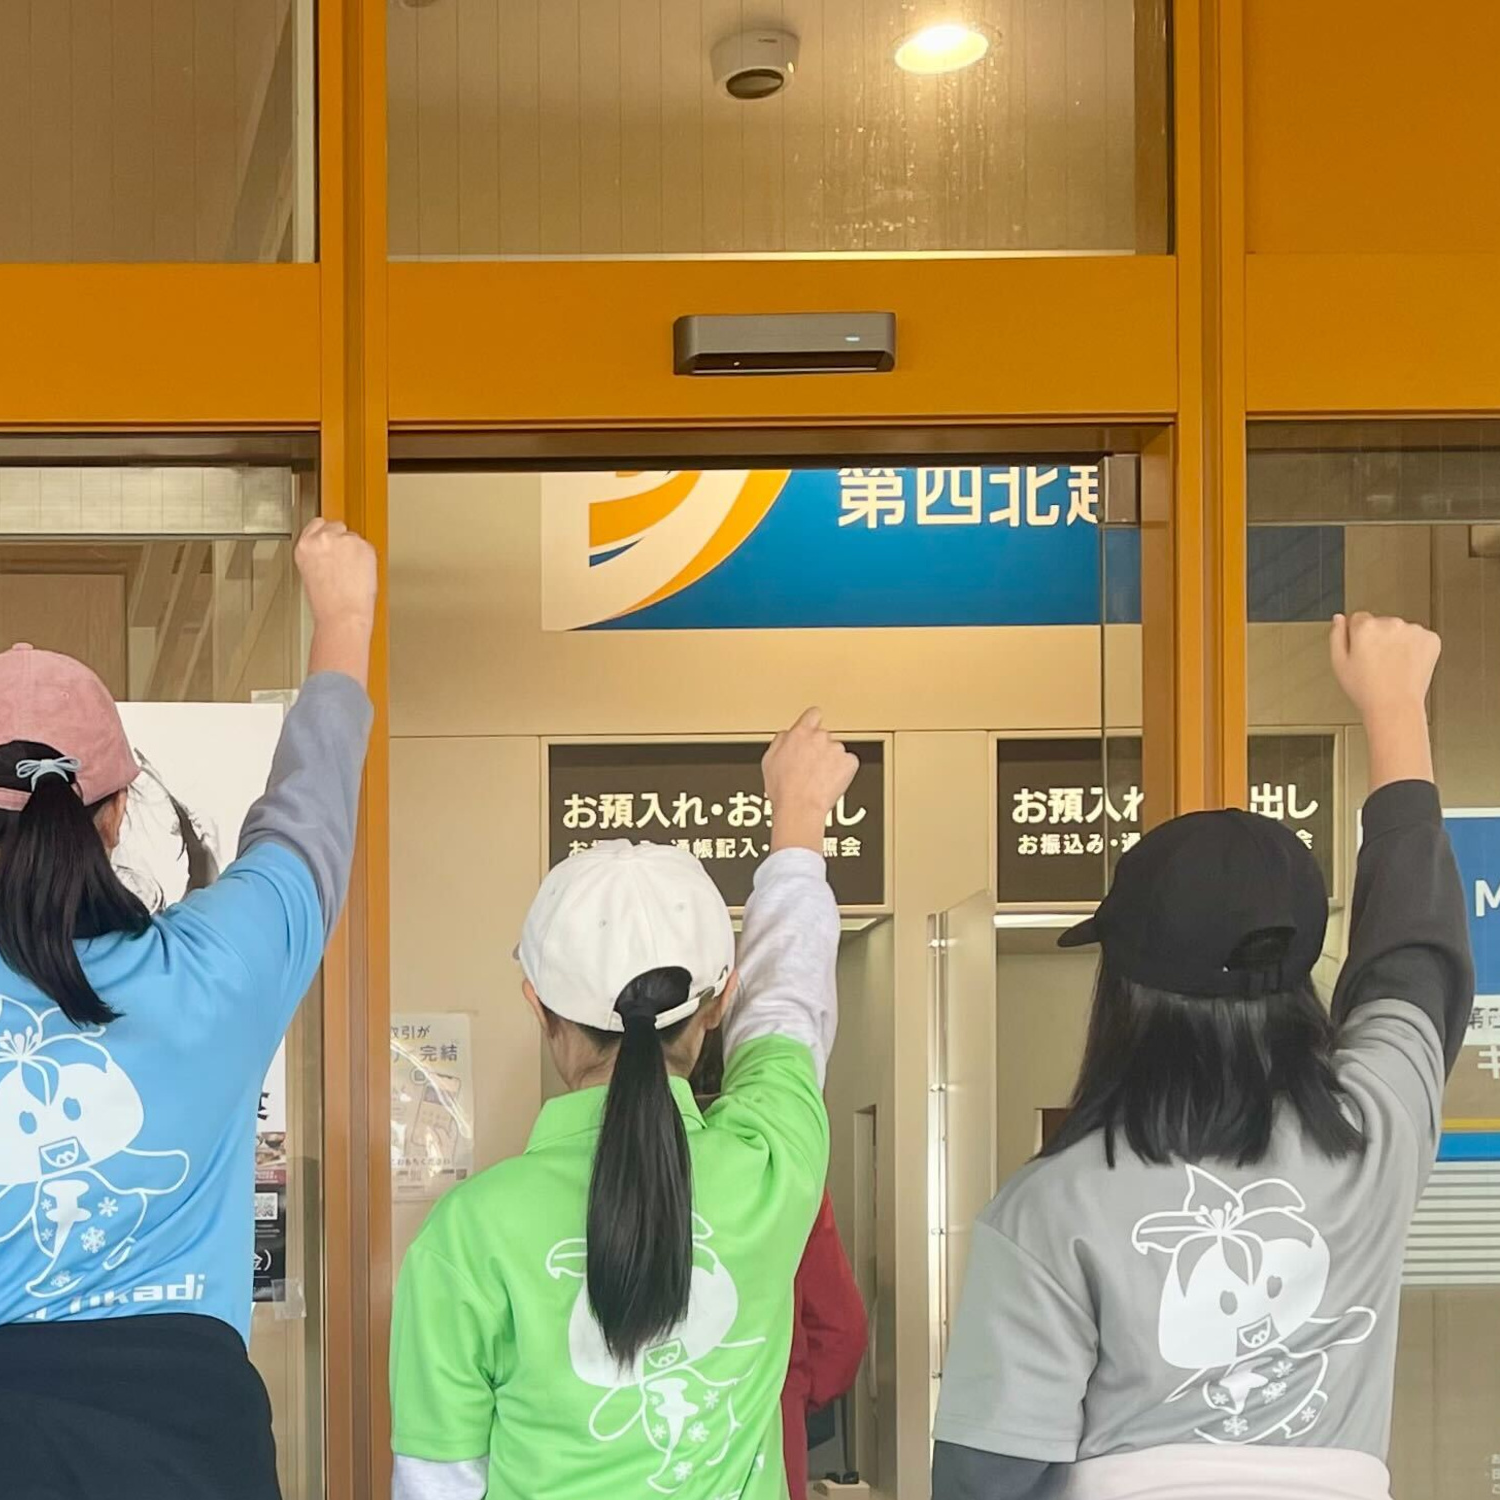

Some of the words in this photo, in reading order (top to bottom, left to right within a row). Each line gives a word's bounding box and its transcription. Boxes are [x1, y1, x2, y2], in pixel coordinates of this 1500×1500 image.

[562, 791, 867, 830] お預入れ・おし
